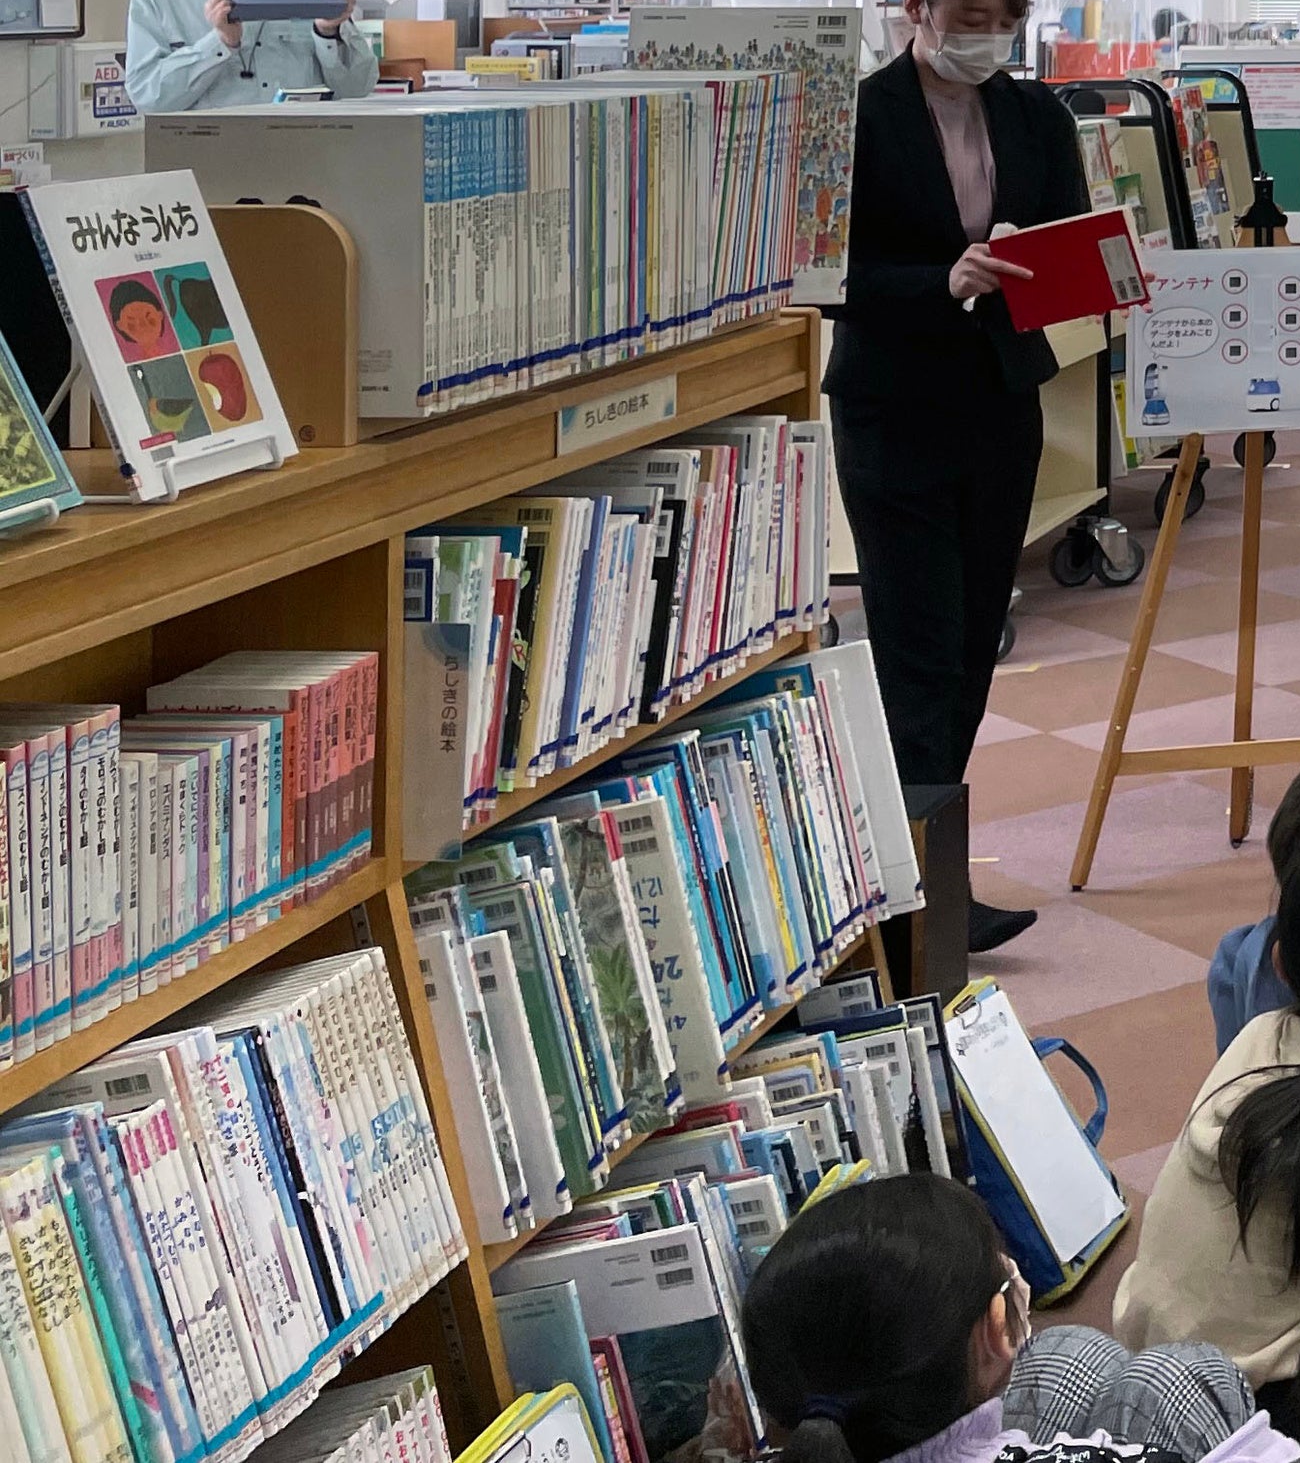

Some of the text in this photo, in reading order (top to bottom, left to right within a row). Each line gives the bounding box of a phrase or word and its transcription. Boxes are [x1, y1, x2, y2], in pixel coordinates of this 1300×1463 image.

[95, 67, 119, 81] AED
[66, 201, 199, 253] みんなうんち
[1156, 277, 1214, 290] アンテナ
[1151, 328, 1212, 338] データをよみこむ
[584, 393, 650, 429] ちしきの絵本
[440, 657, 459, 753] ちしきの絵本
